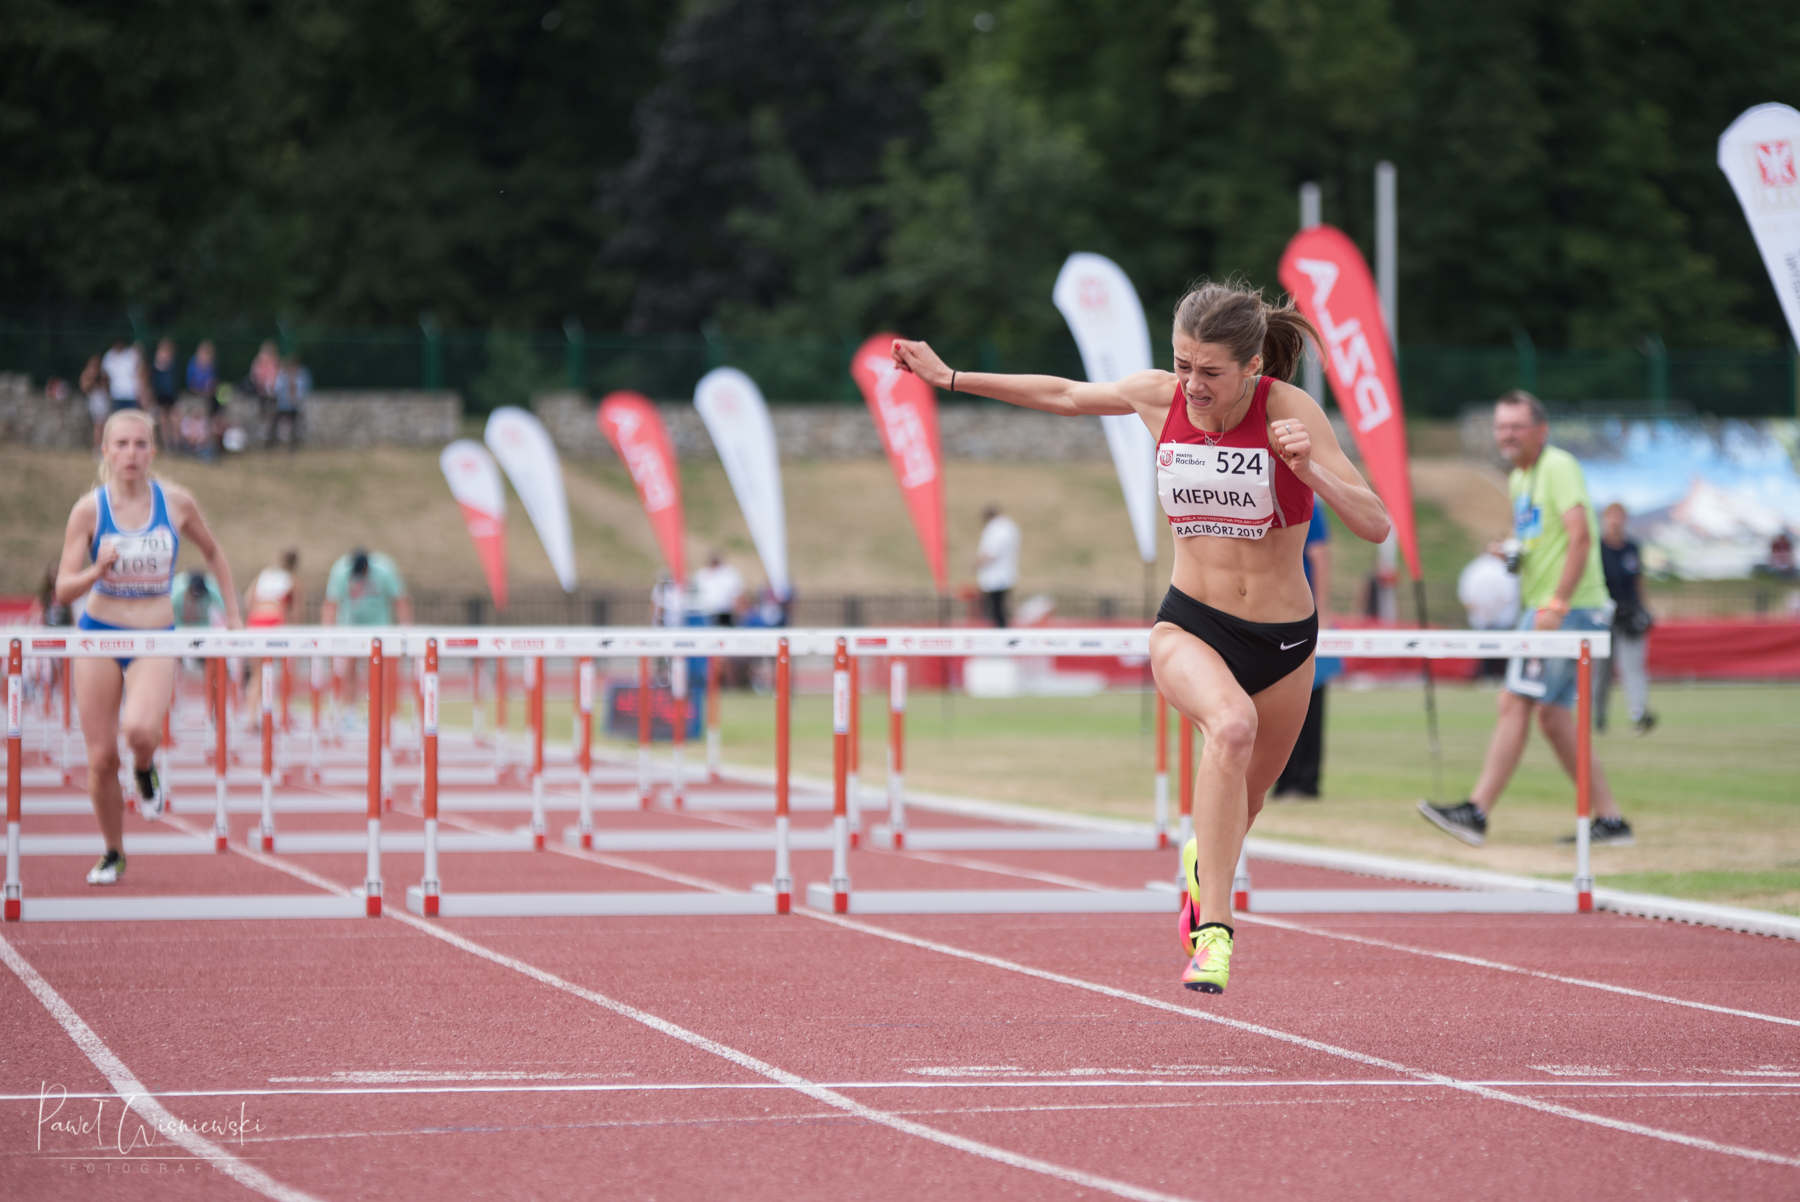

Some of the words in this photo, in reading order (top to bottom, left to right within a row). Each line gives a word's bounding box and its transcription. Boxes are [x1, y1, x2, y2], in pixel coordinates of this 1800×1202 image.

[1175, 458, 1206, 466] Racibórz
[1216, 451, 1263, 475] 524
[1172, 488, 1257, 508] KIEPURA
[1176, 523, 1235, 536] RACIBÓRZ
[1236, 528, 1263, 537] 2019
